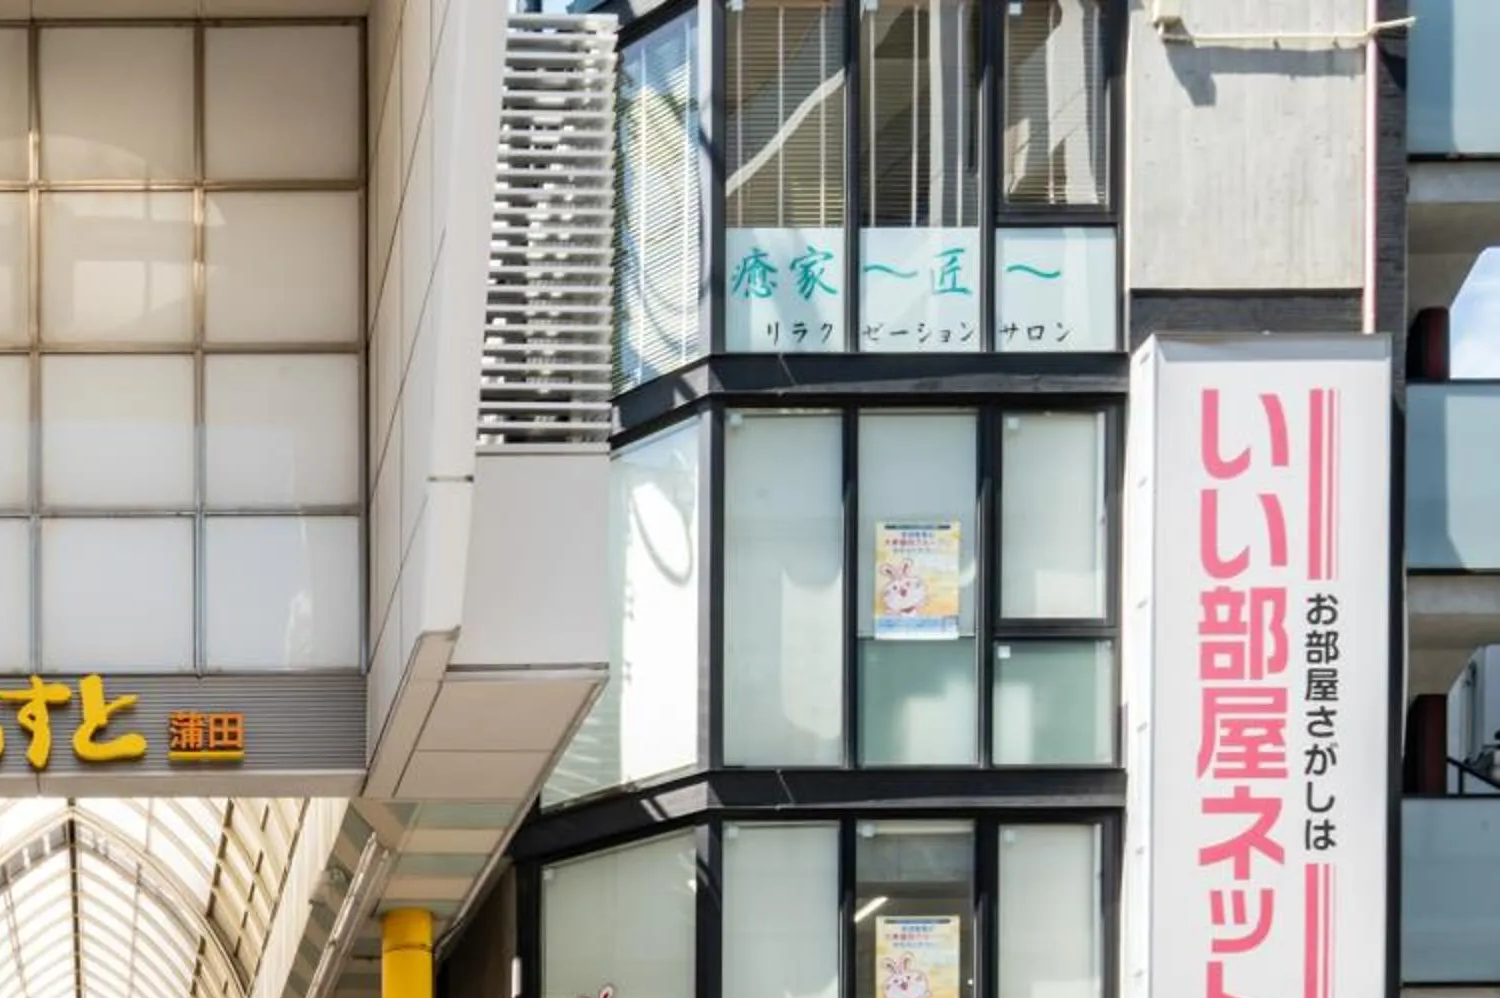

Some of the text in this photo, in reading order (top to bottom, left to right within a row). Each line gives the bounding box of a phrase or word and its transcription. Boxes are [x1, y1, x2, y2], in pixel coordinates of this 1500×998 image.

[168, 711, 246, 752] 蒲田
[1303, 592, 1342, 851] お部屋さがしは
